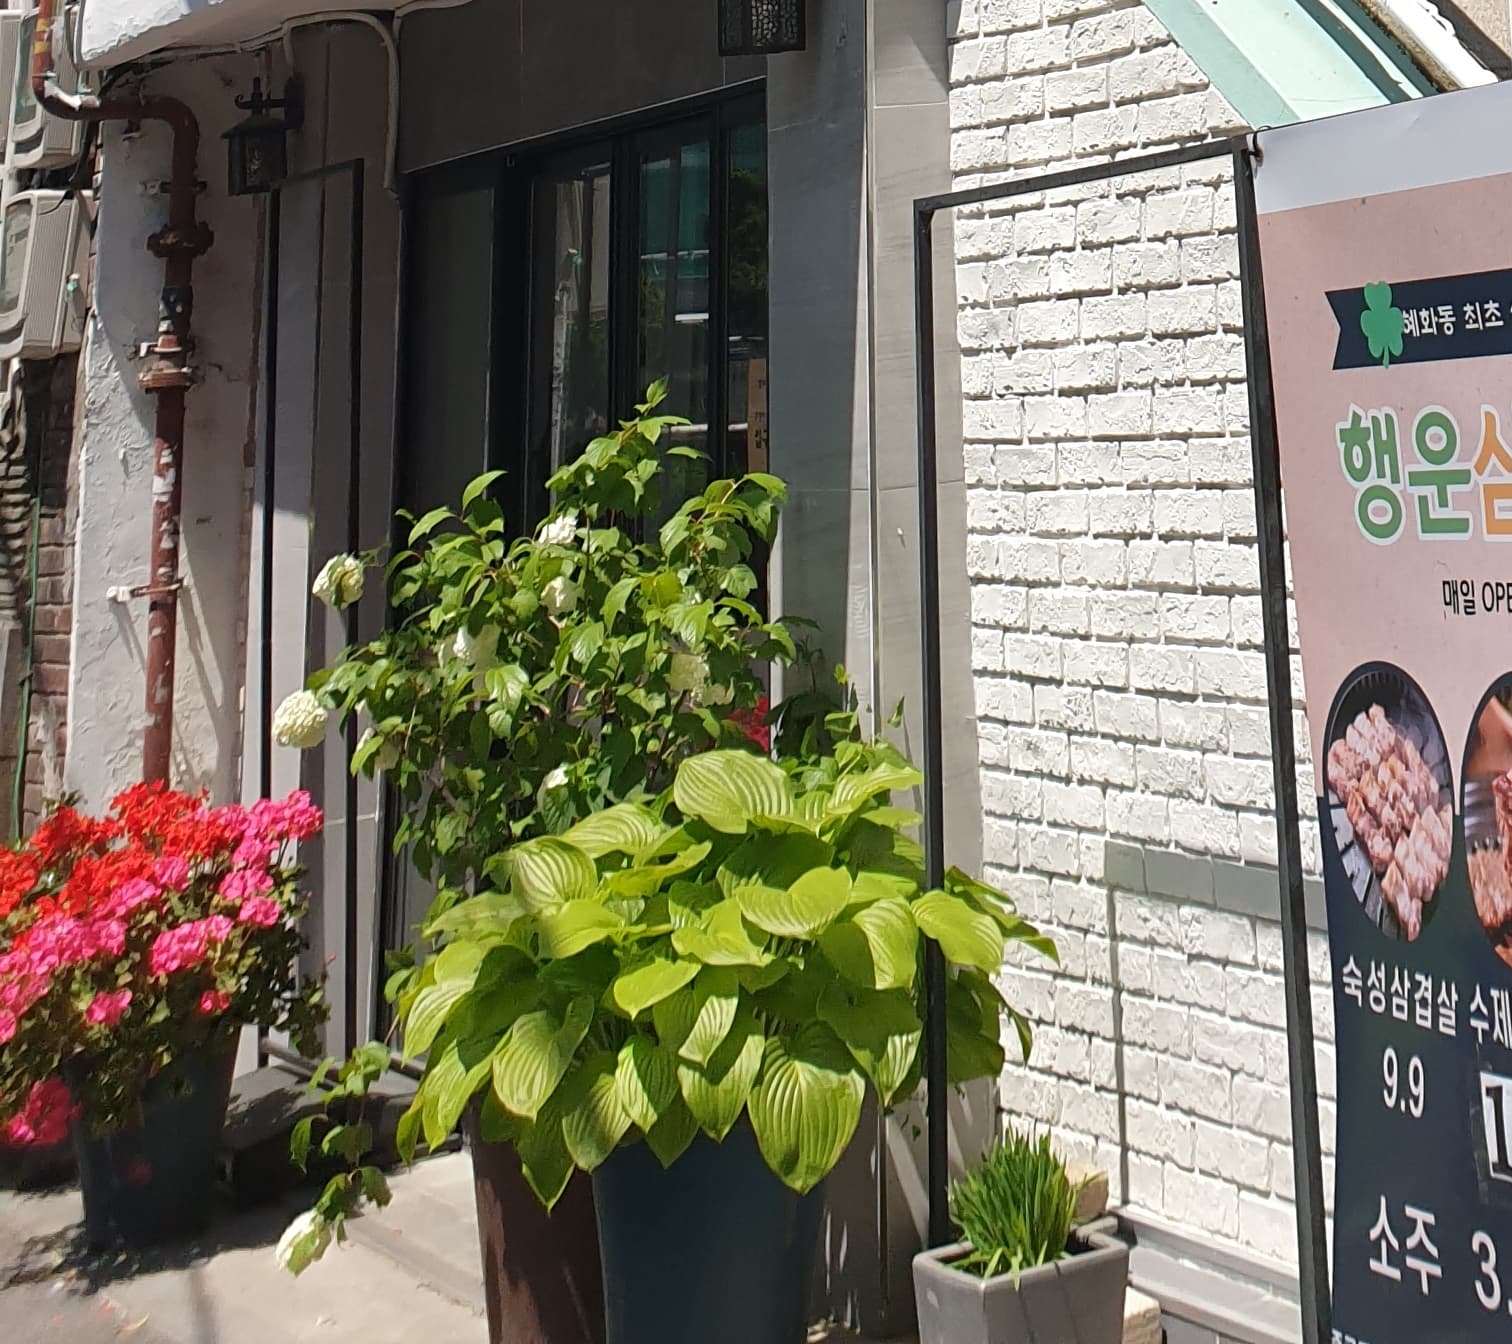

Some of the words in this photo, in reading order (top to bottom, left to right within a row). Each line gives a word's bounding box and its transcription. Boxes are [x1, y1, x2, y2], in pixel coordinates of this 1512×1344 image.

[1402, 304, 1457, 337] 혜화동
[1463, 300, 1504, 330] 최초
[1442, 579, 1476, 616] 매일
[1341, 954, 1458, 1036] 숙성삼겹살
[1382, 1047, 1425, 1118] 9.9
[1368, 1194, 1443, 1295] 소주
